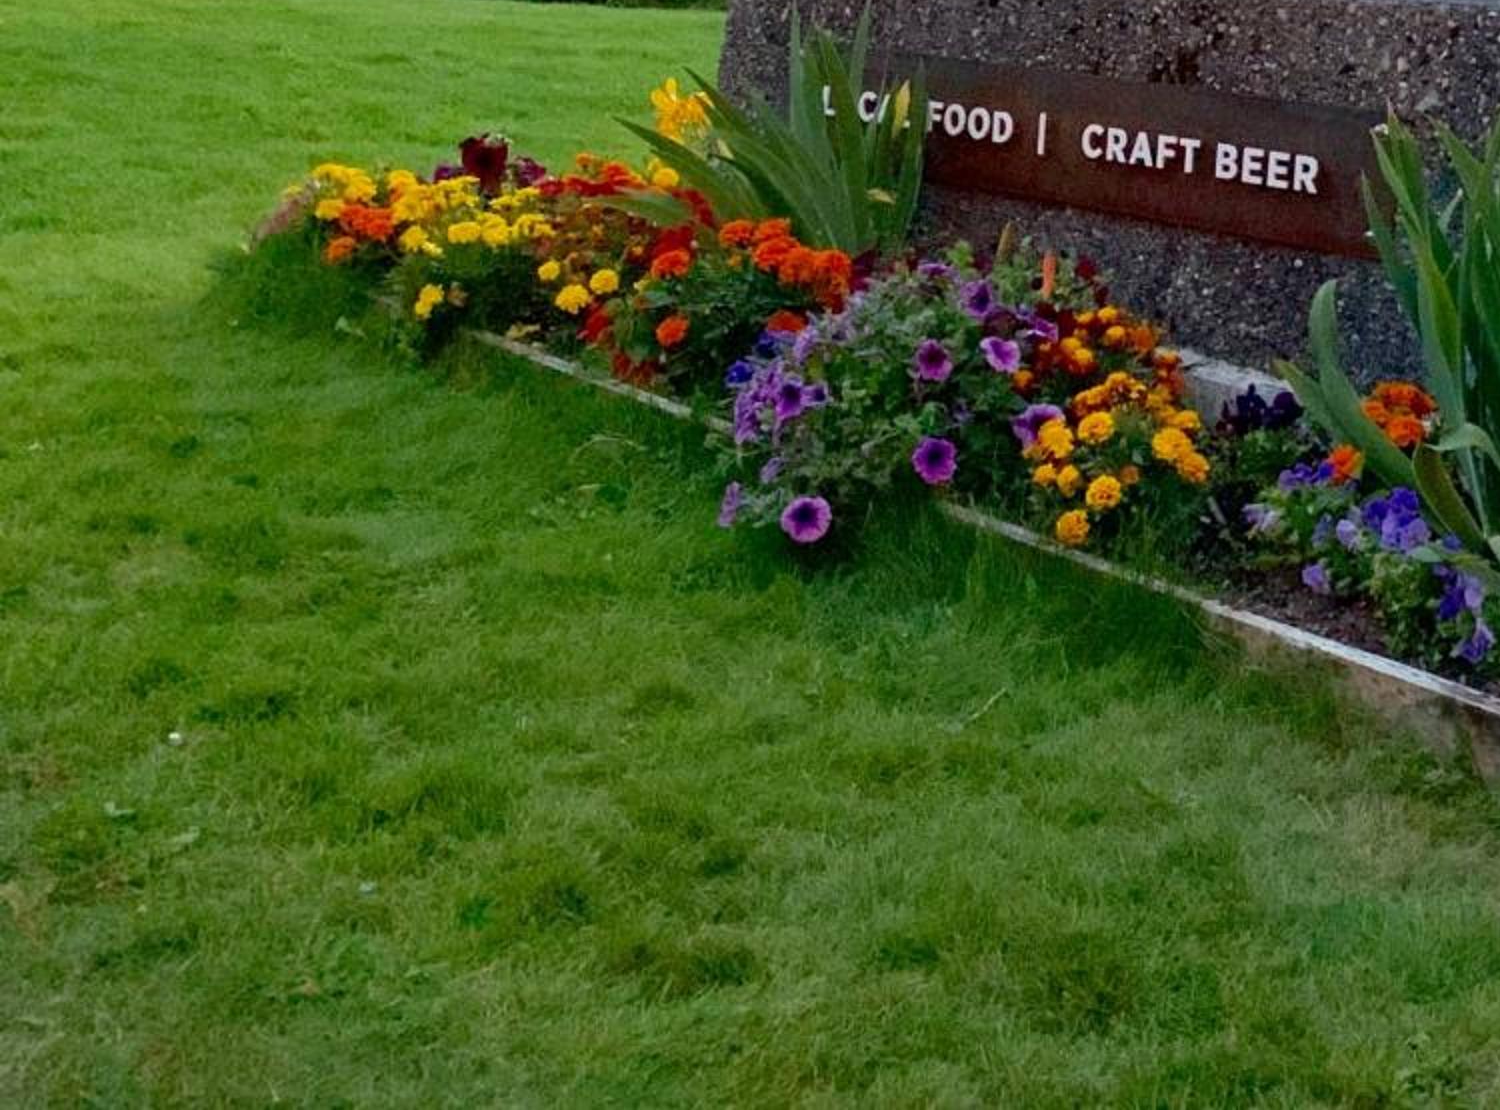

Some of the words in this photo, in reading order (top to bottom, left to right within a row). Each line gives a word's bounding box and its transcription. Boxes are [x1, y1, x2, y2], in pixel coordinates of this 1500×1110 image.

[926, 100, 1014, 144] FOOD
[1080, 123, 1201, 173] CRAFT
[1214, 142, 1320, 194] BEER
